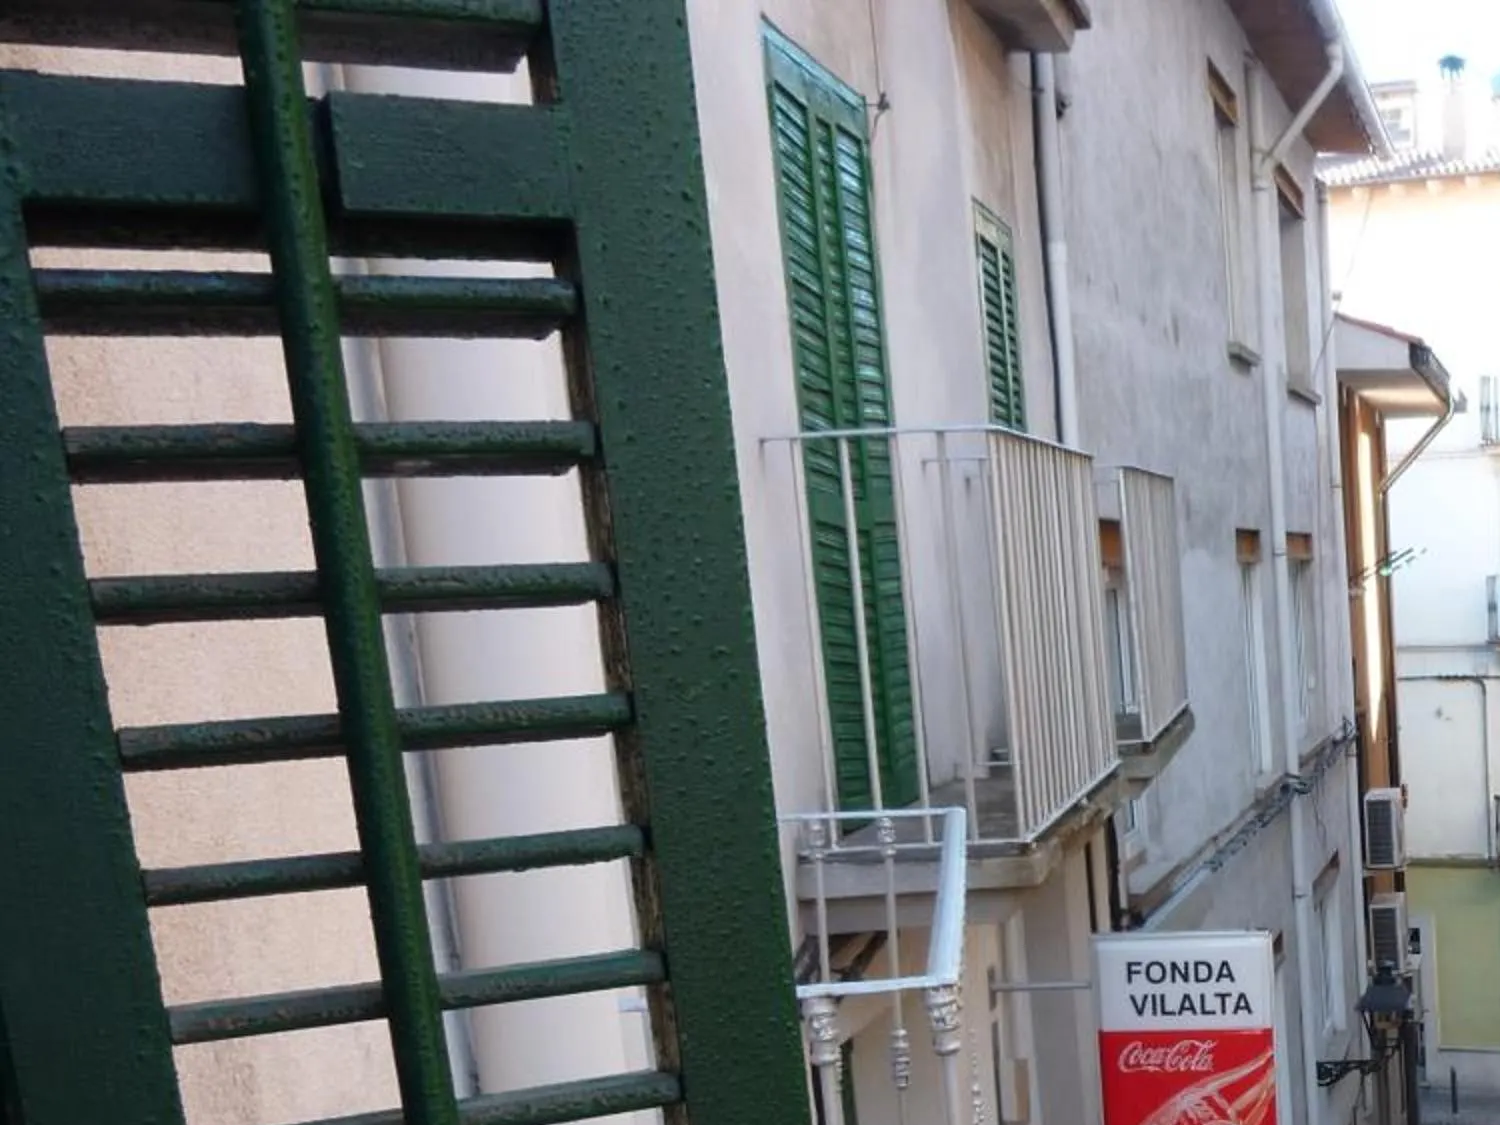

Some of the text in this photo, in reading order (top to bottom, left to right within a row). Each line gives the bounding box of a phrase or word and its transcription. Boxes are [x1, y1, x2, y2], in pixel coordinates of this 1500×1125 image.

[1126, 960, 1236, 984] FONDA
[1130, 992, 1253, 1016] VILALTA
[1119, 1039, 1218, 1072] Coca-Cola
